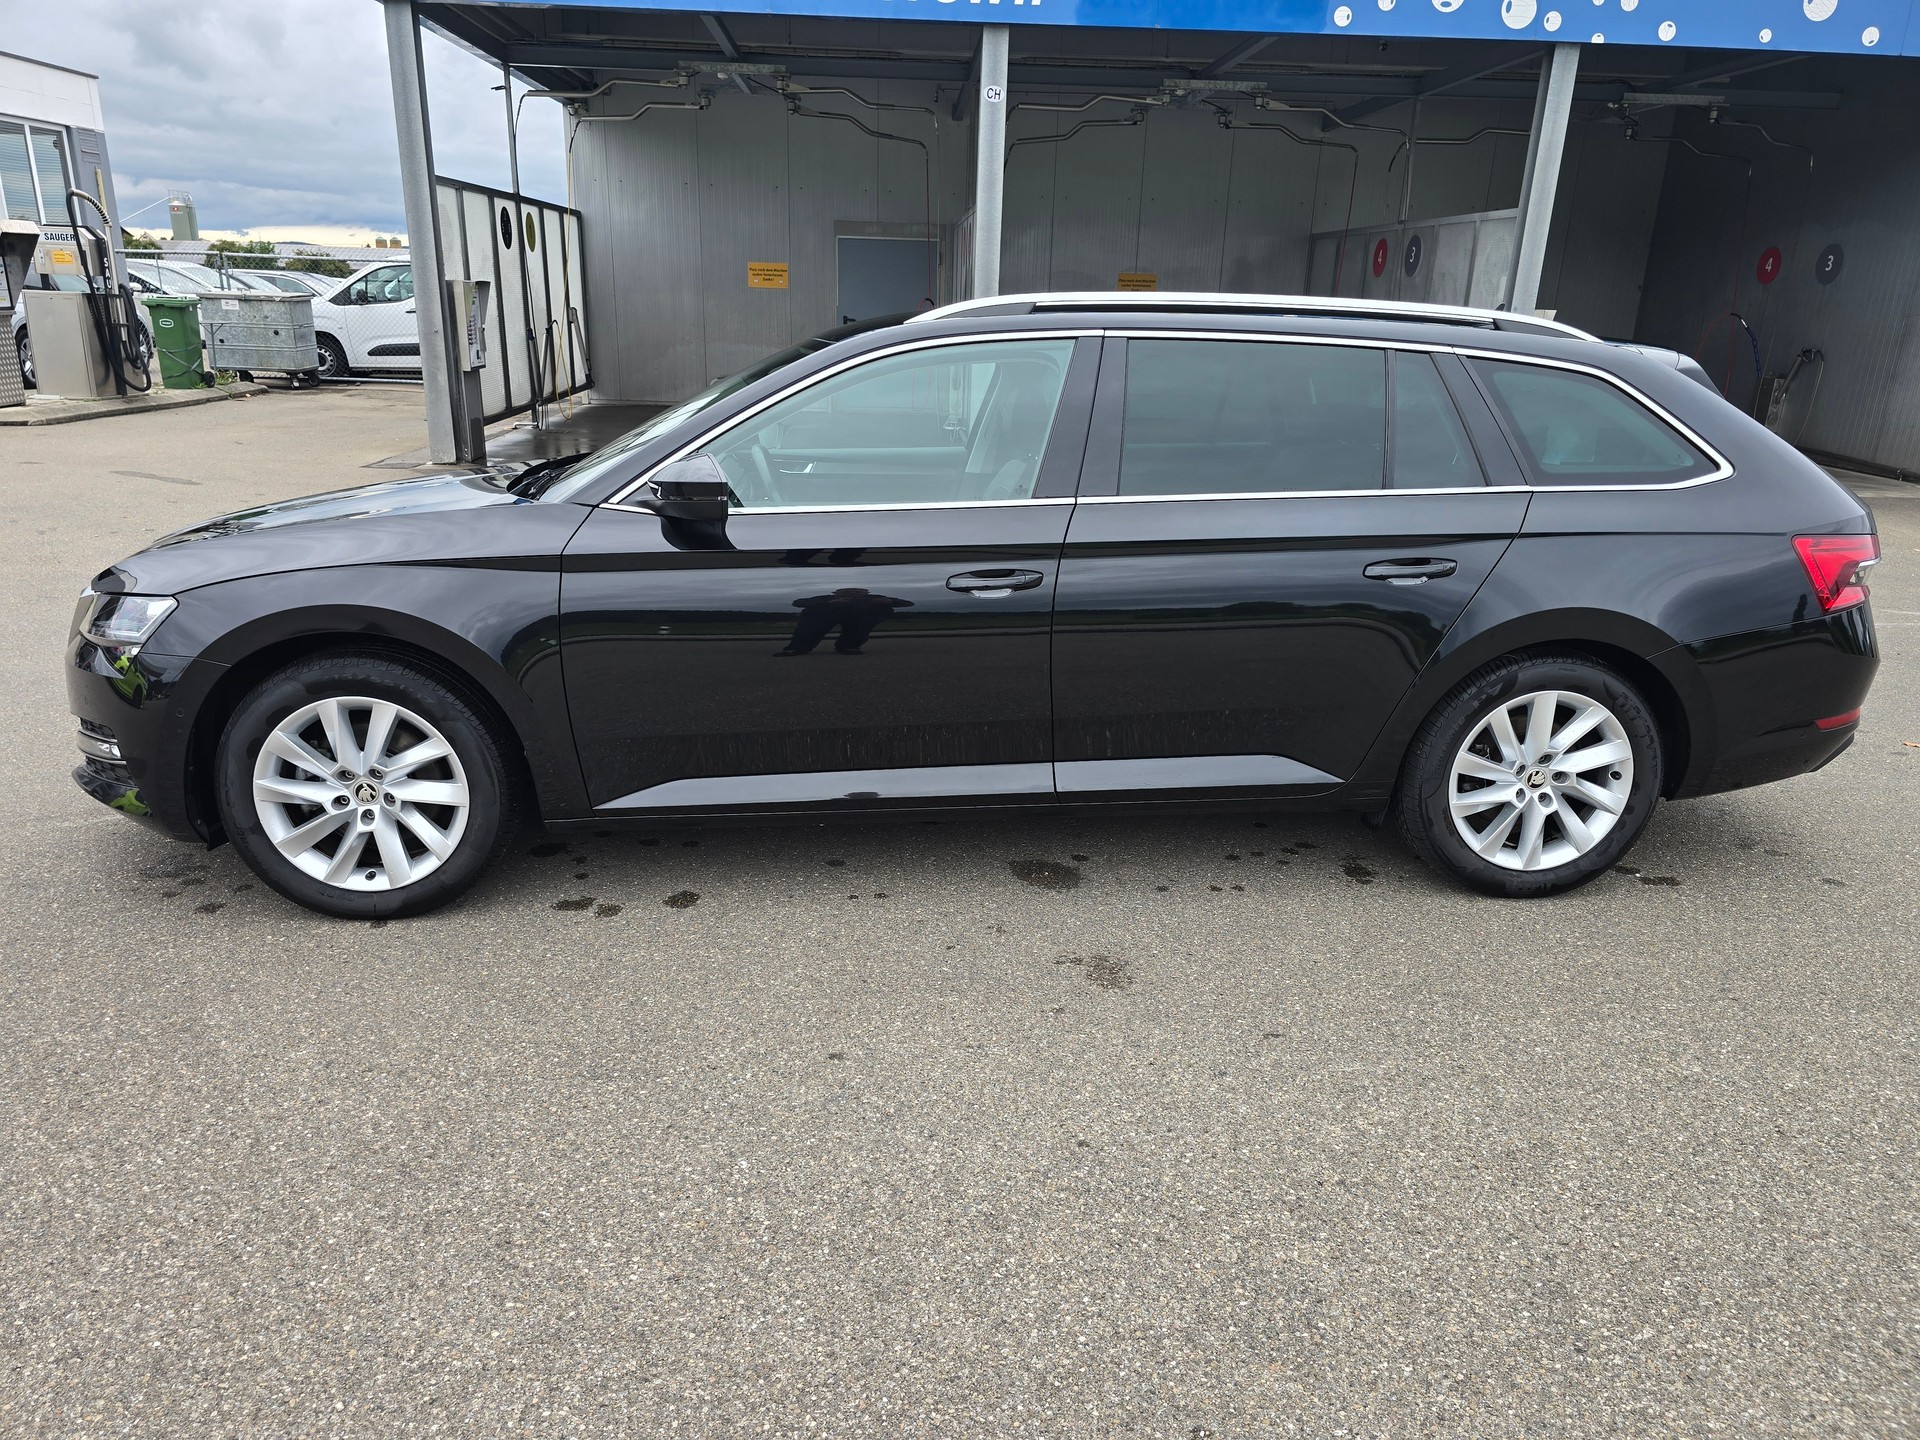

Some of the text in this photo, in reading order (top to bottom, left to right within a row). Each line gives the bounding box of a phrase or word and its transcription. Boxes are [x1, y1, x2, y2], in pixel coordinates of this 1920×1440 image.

[986, 87, 1001, 100] CH
[44, 232, 76, 241] SAUGER
[1377, 249, 1382, 265] 4
[1409, 246, 1416, 263] 3
[1765, 257, 1773, 273] 4
[1824, 255, 1834, 272] 3
